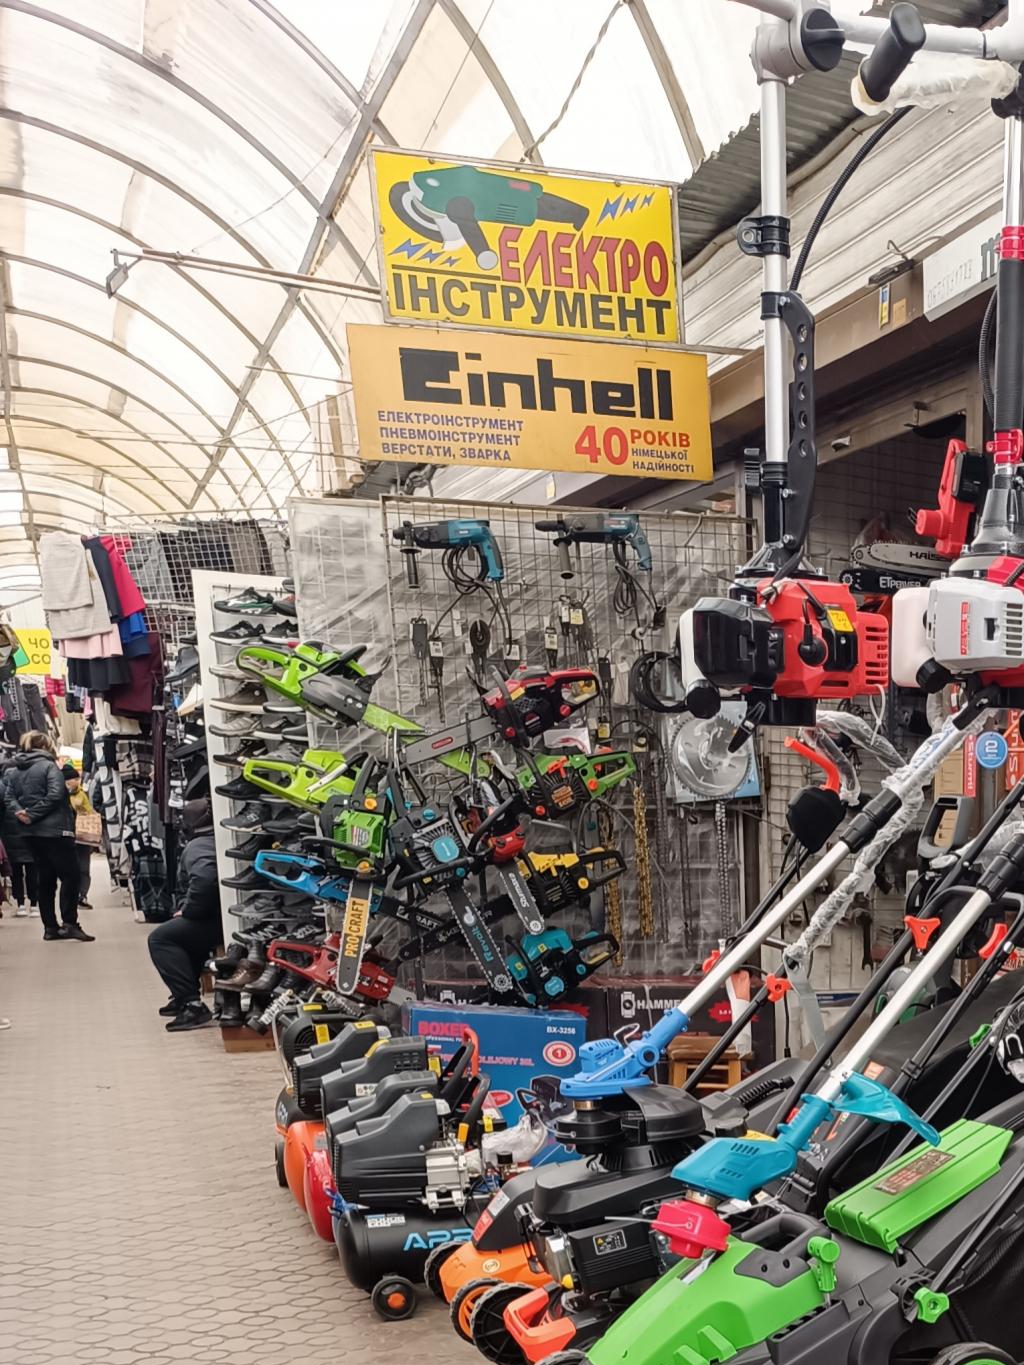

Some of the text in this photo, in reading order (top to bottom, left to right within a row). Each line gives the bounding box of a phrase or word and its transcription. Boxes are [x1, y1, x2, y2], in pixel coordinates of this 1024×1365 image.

[499, 226, 669, 297] ЕЛЕКТРО
[392, 273, 671, 335] ІНСТРУМЕНТ
[399, 347, 673, 421] Einhell
[378, 410, 523, 431] ЕЛЕКТРОІНСТРУМЕНТ
[380, 427, 520, 446] ПНЕВМОІНСТРУМЕНТ
[575, 425, 690, 465] 40 РОКІВ
[382, 443, 511, 461] ВЕРСТАТИ, ЗВАРКА
[631, 448, 688, 461] НІМЕЦЬКОЇ
[633, 461, 694, 473] НАДІЙНОСТІ
[637, 1000, 683, 1010] HAMME
